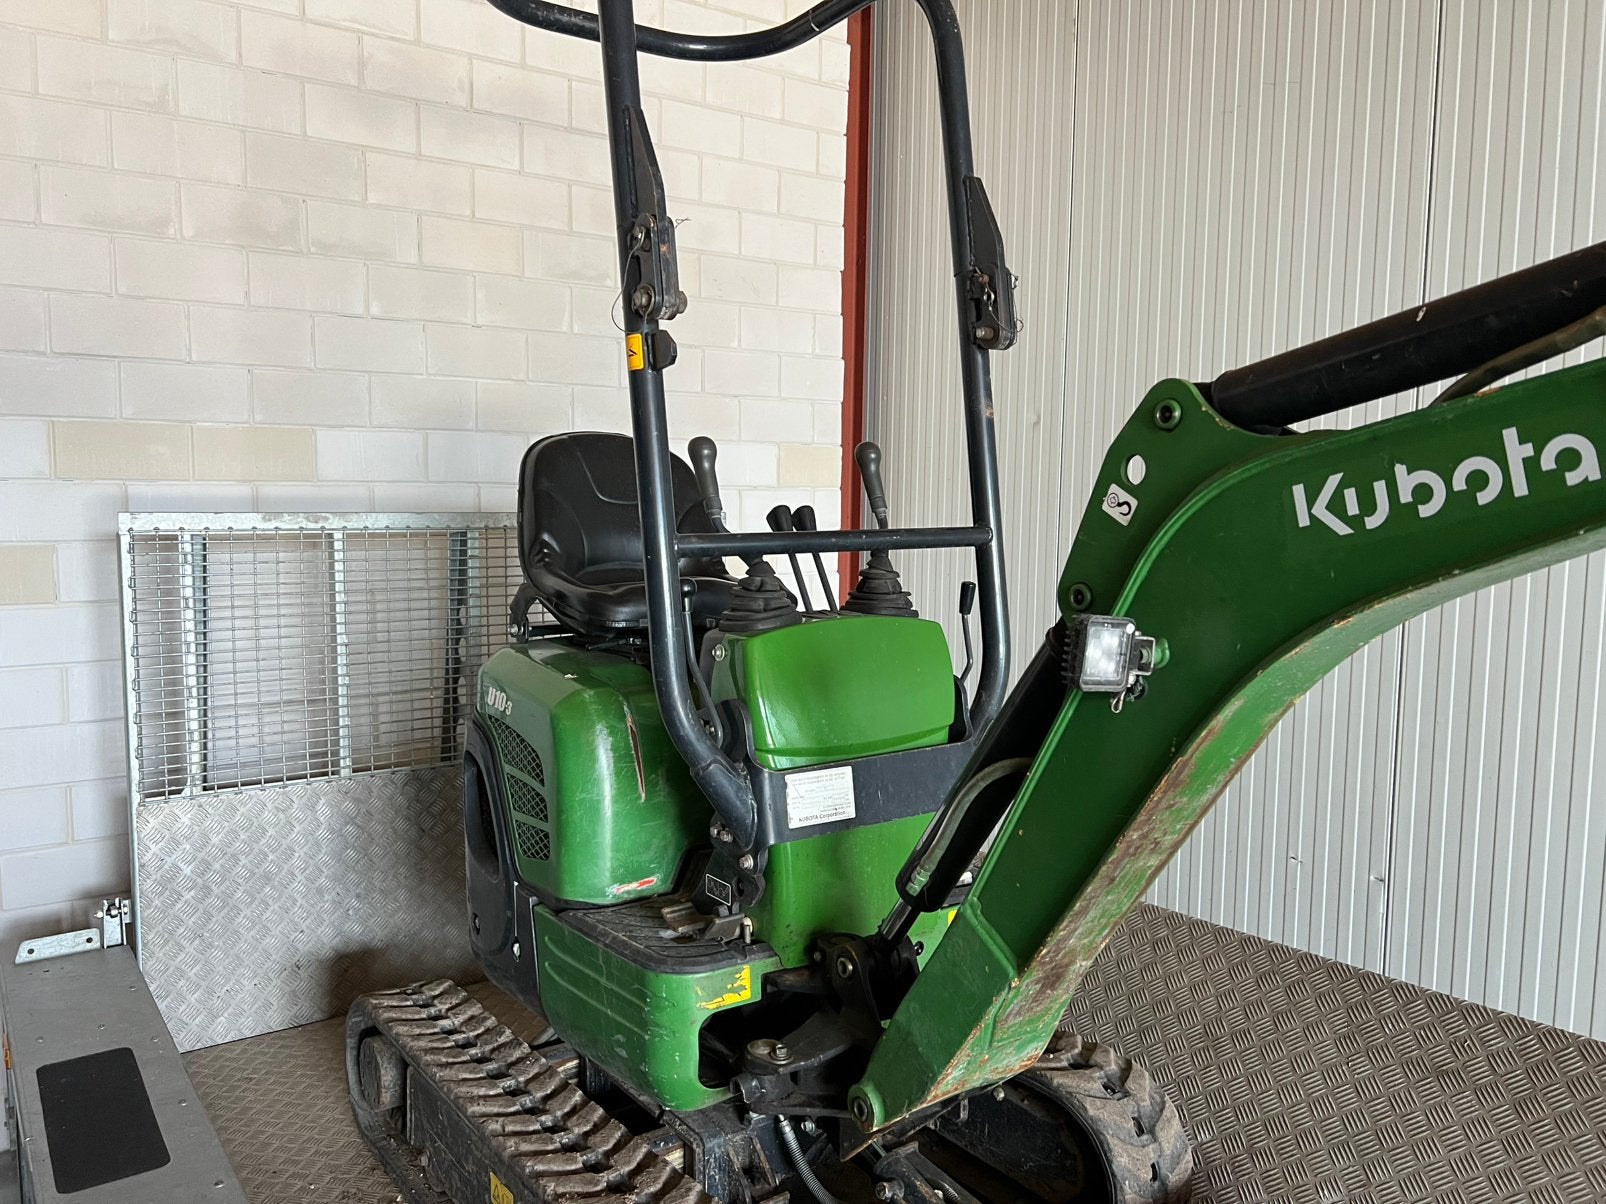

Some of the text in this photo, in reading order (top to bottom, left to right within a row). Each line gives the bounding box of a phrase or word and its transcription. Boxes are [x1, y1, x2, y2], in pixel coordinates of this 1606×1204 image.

[1292, 426, 1602, 536] Kubota
[798, 811, 846, 823] KUBOTA Corporation
